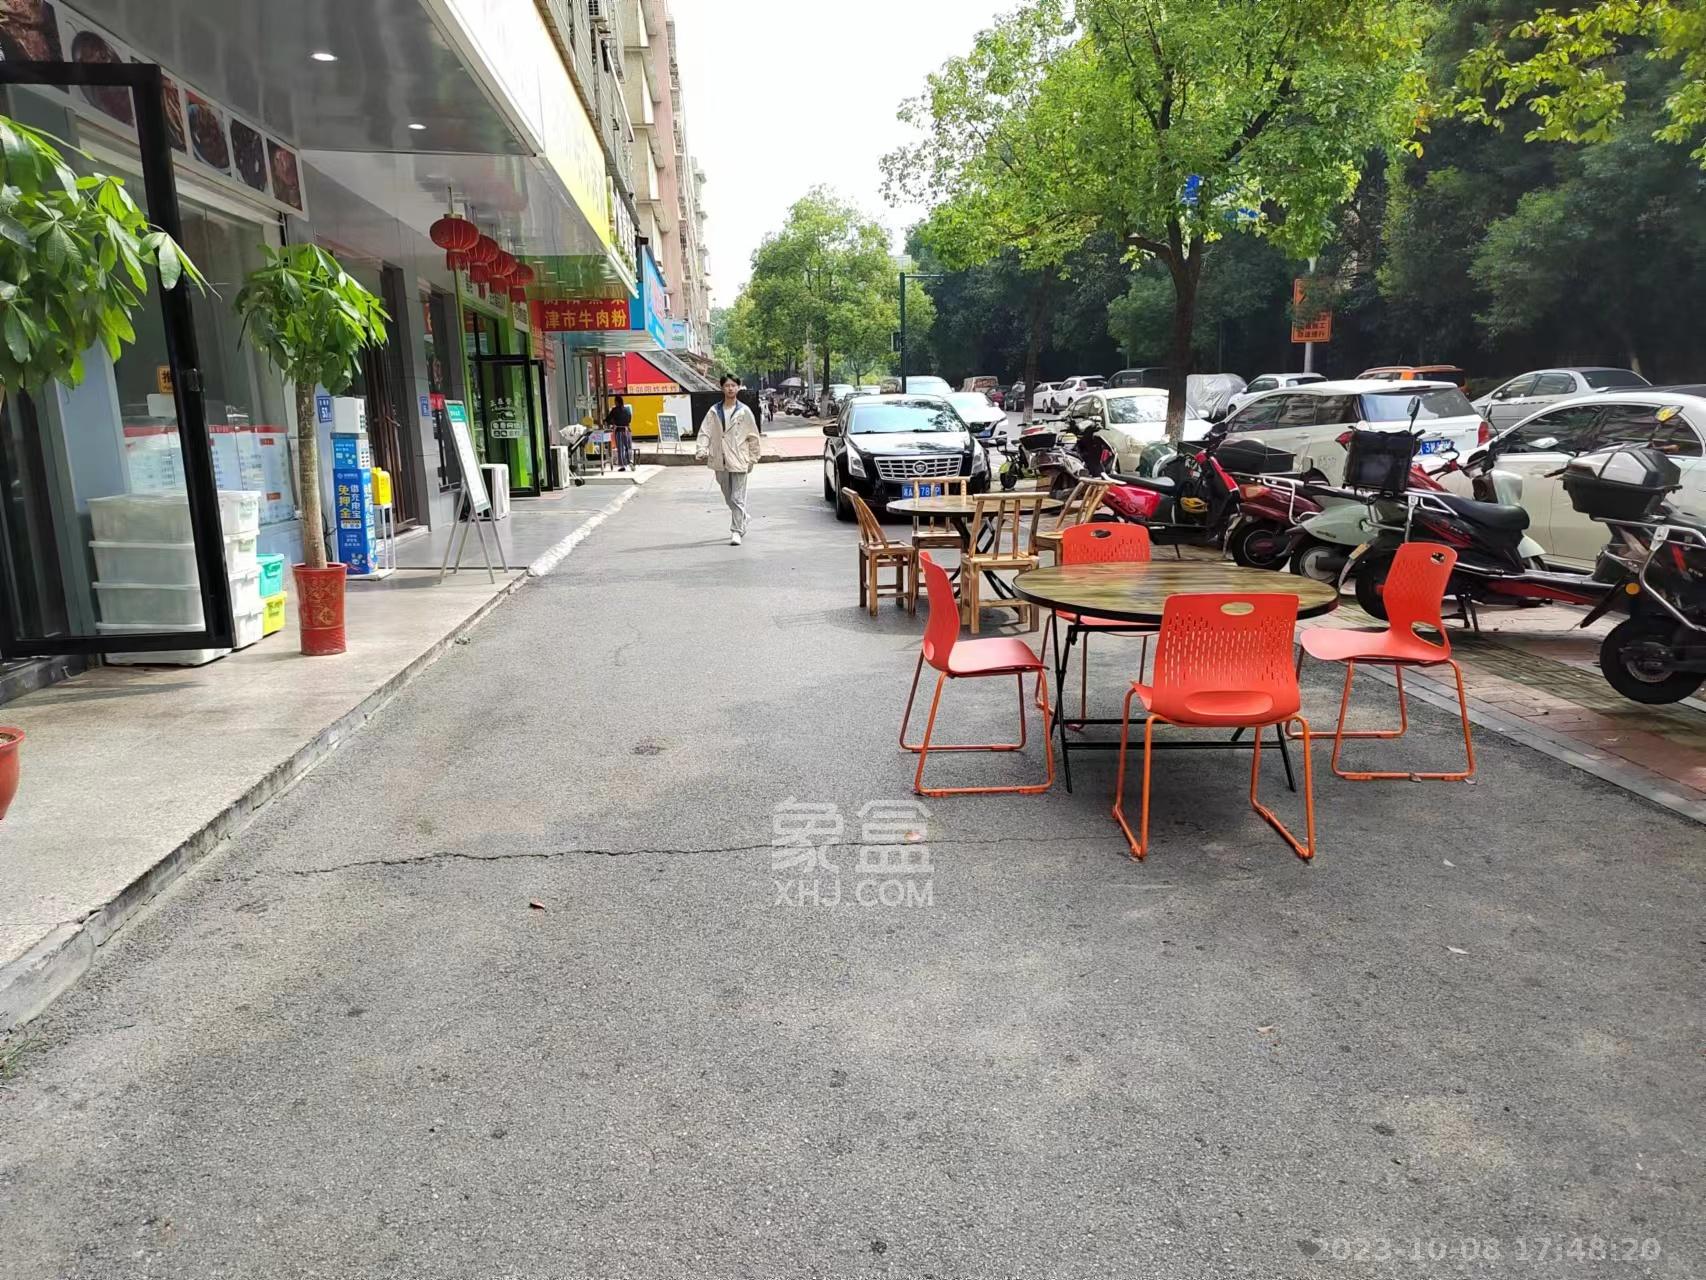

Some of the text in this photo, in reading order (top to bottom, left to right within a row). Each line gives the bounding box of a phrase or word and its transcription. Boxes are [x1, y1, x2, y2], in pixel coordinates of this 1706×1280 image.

[545, 309, 626, 329] 津市牛肉粉
[338, 484, 351, 519] 免押金
[350, 484, 362, 519] 借充电宝
